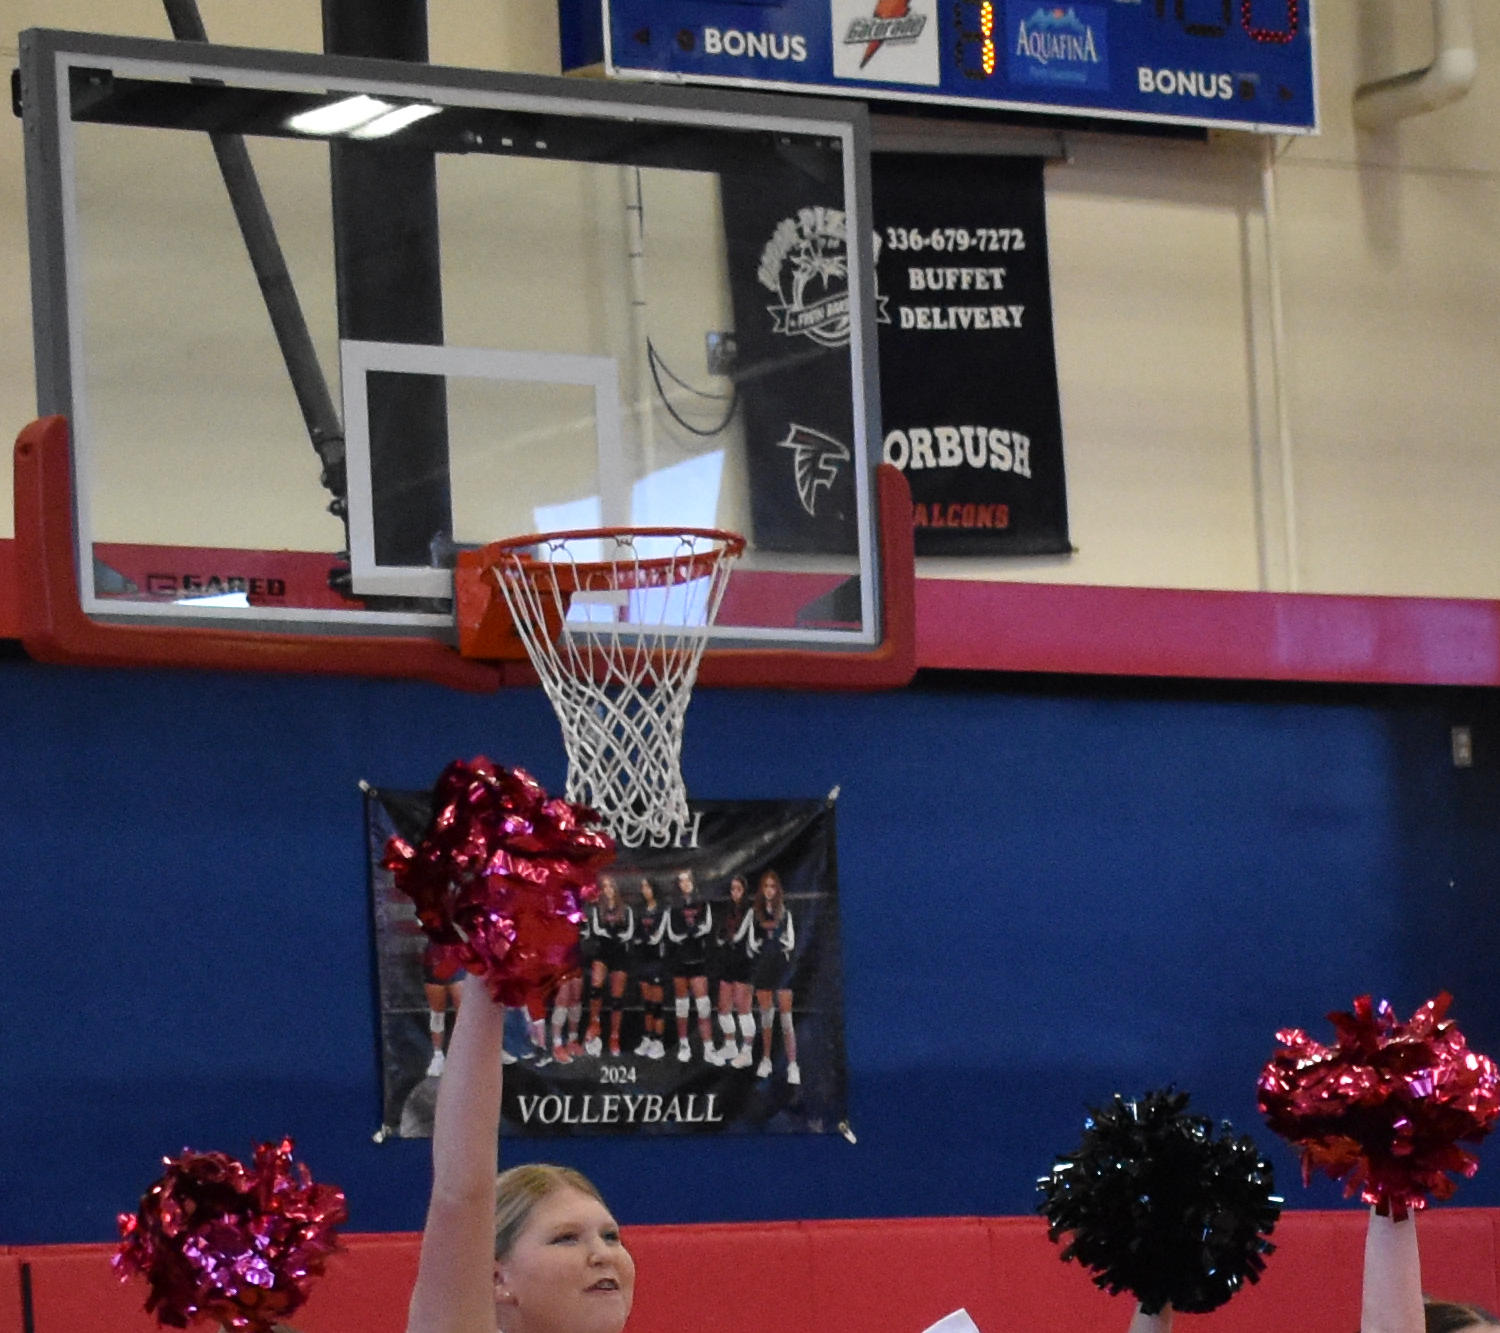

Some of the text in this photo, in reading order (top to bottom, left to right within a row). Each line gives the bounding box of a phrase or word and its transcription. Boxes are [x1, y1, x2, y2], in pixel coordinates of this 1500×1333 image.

[703, 26, 808, 63] BONUS
[1016, 21, 1098, 64] AQUAFINA
[1137, 67, 1233, 100] BONUS
[886, 226, 1026, 251] 336-679-7272
[908, 267, 1006, 290] BUFFET
[899, 305, 1025, 329] DELIVERY
[882, 425, 1031, 479] ORBUSH
[911, 503, 1009, 529] ALCONS
[600, 1066, 636, 1084] 2024
[517, 1094, 724, 1124] VOLLEYBALL
